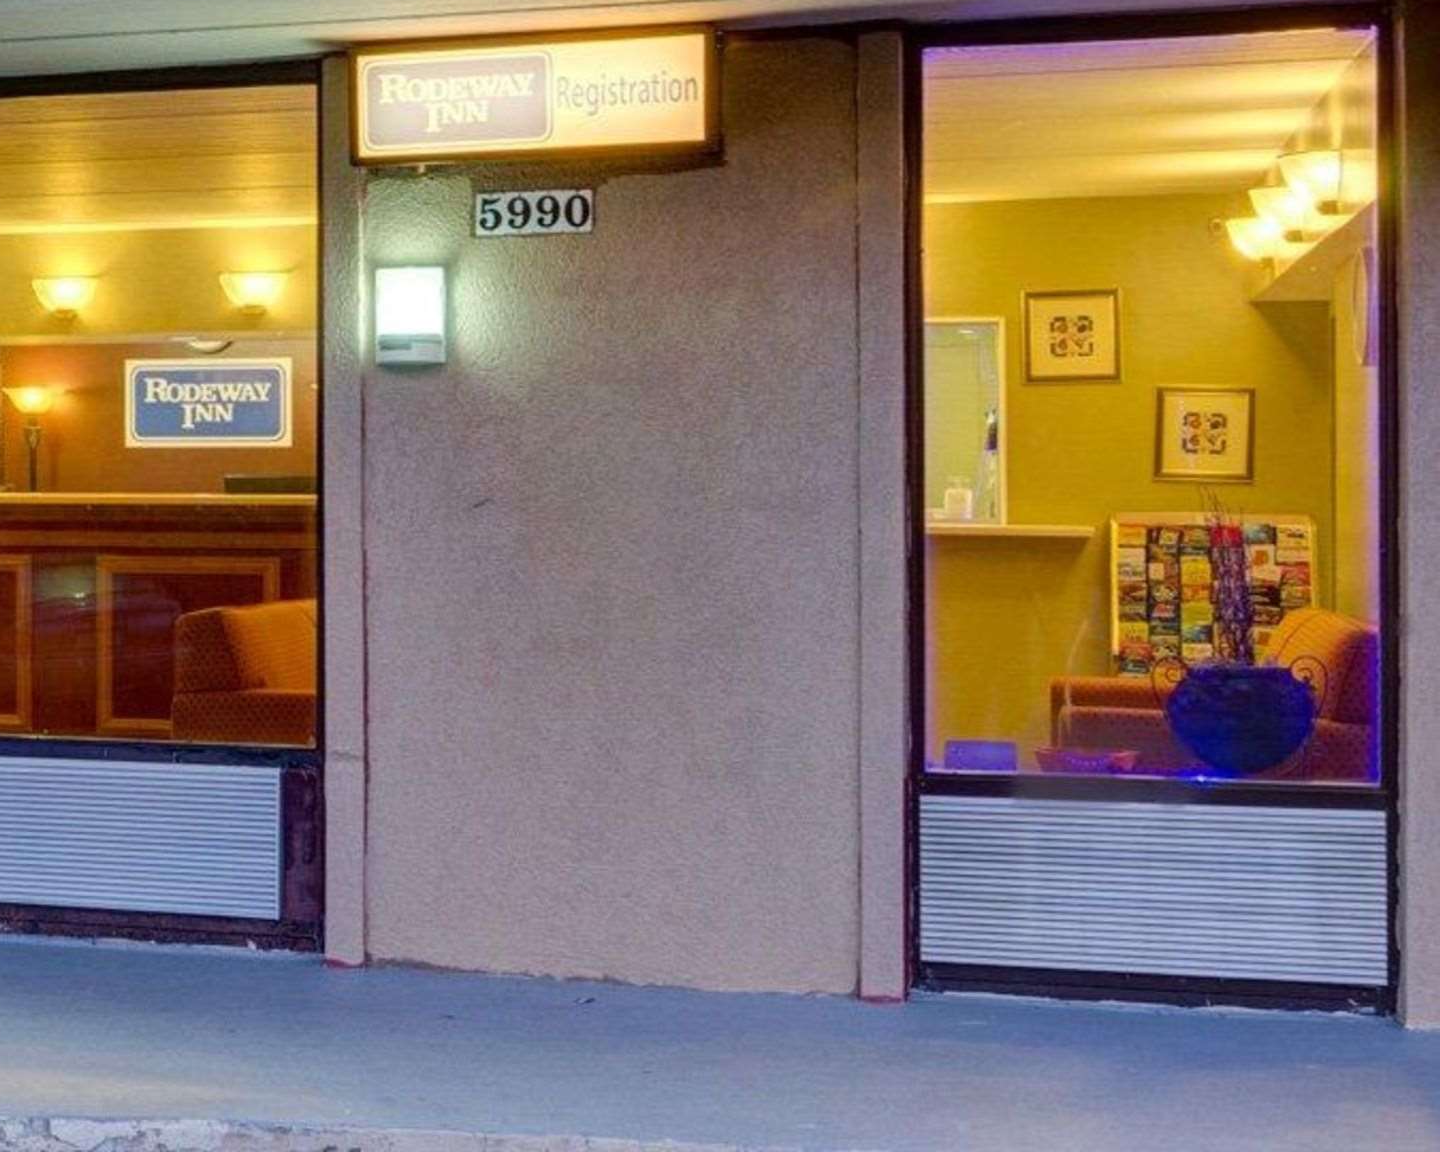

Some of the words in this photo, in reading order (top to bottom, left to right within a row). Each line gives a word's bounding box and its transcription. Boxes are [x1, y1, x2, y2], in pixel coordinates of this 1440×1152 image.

[377, 72, 536, 105] RODEWAY
[557, 70, 699, 117] Registration
[426, 98, 490, 134] INN
[478, 191, 591, 231] 5990
[143, 377, 272, 404] RODEWAY
[181, 402, 235, 430] INN
